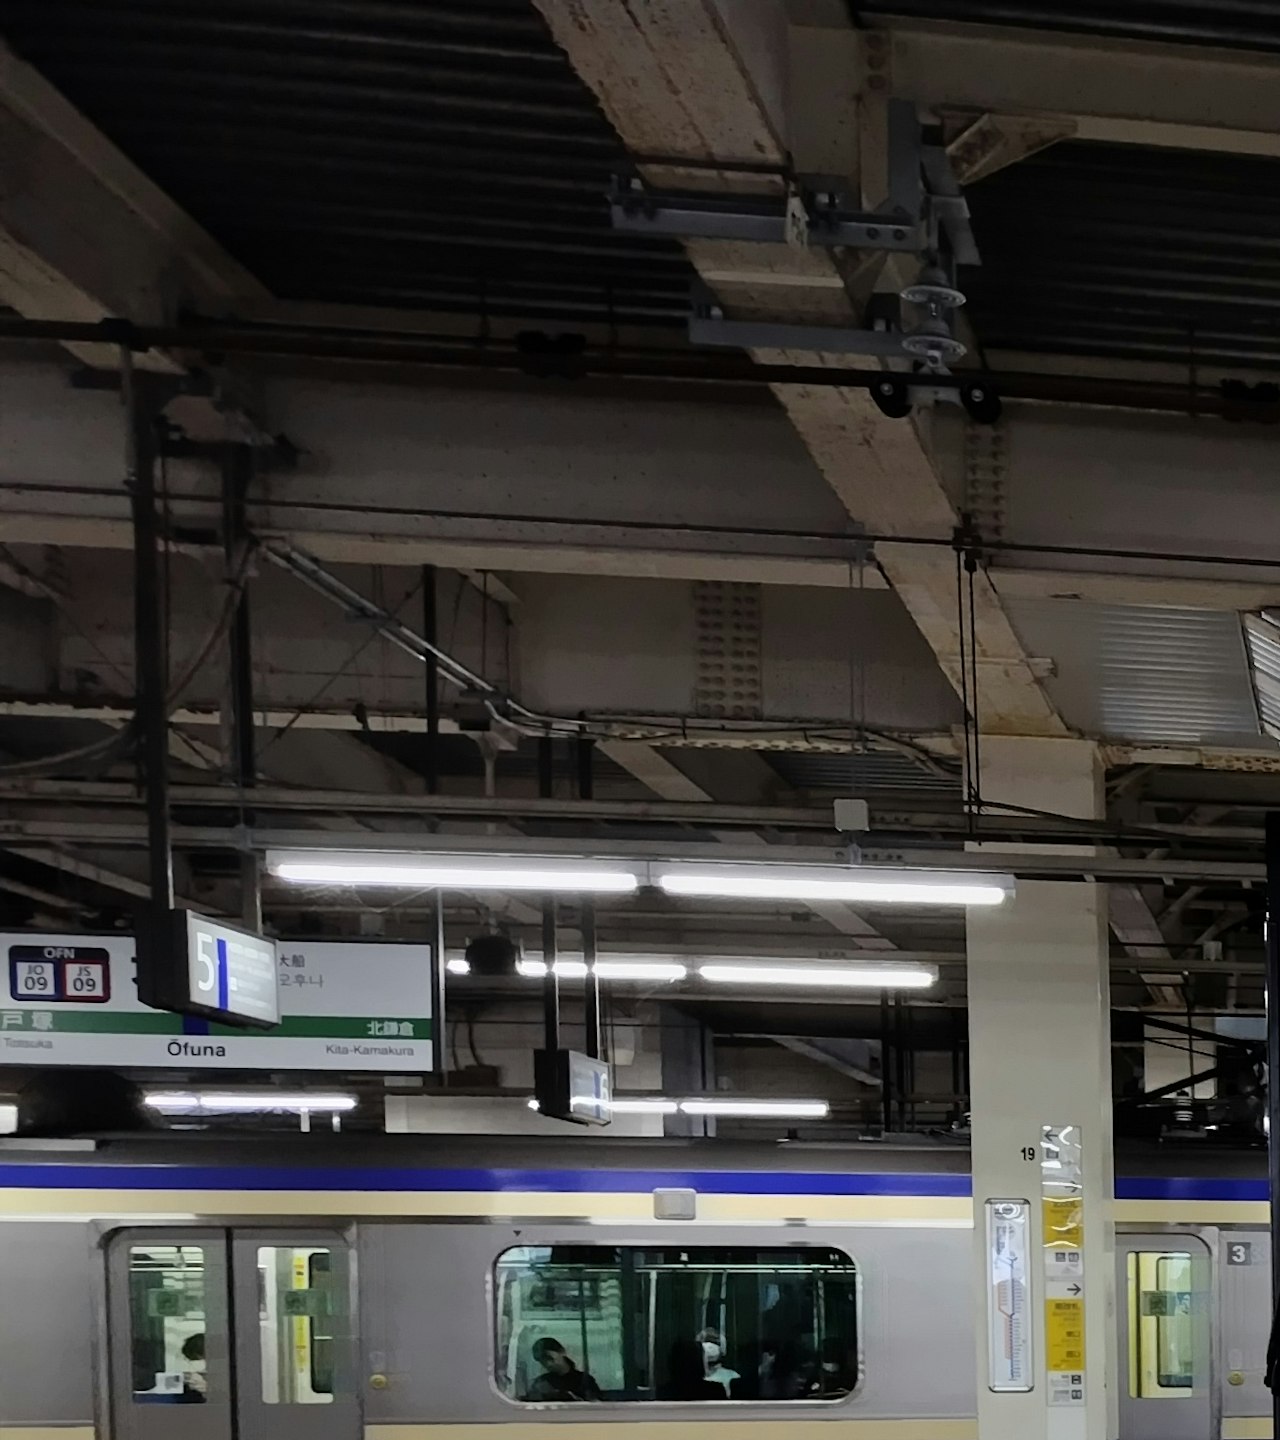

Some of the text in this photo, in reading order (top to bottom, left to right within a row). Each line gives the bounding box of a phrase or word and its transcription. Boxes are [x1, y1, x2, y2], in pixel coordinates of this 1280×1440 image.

[44, 947, 75, 959] OFN
[197, 931, 215, 991] 5
[27, 965, 45, 976] JO
[77, 966, 92, 977] JS
[24, 976, 49, 991] 09
[73, 978, 97, 992] 09
[326, 1044, 415, 1057] Kita-Kamakura
[1021, 1147, 1035, 1160] 19
[1231, 1245, 1246, 1263] 3
